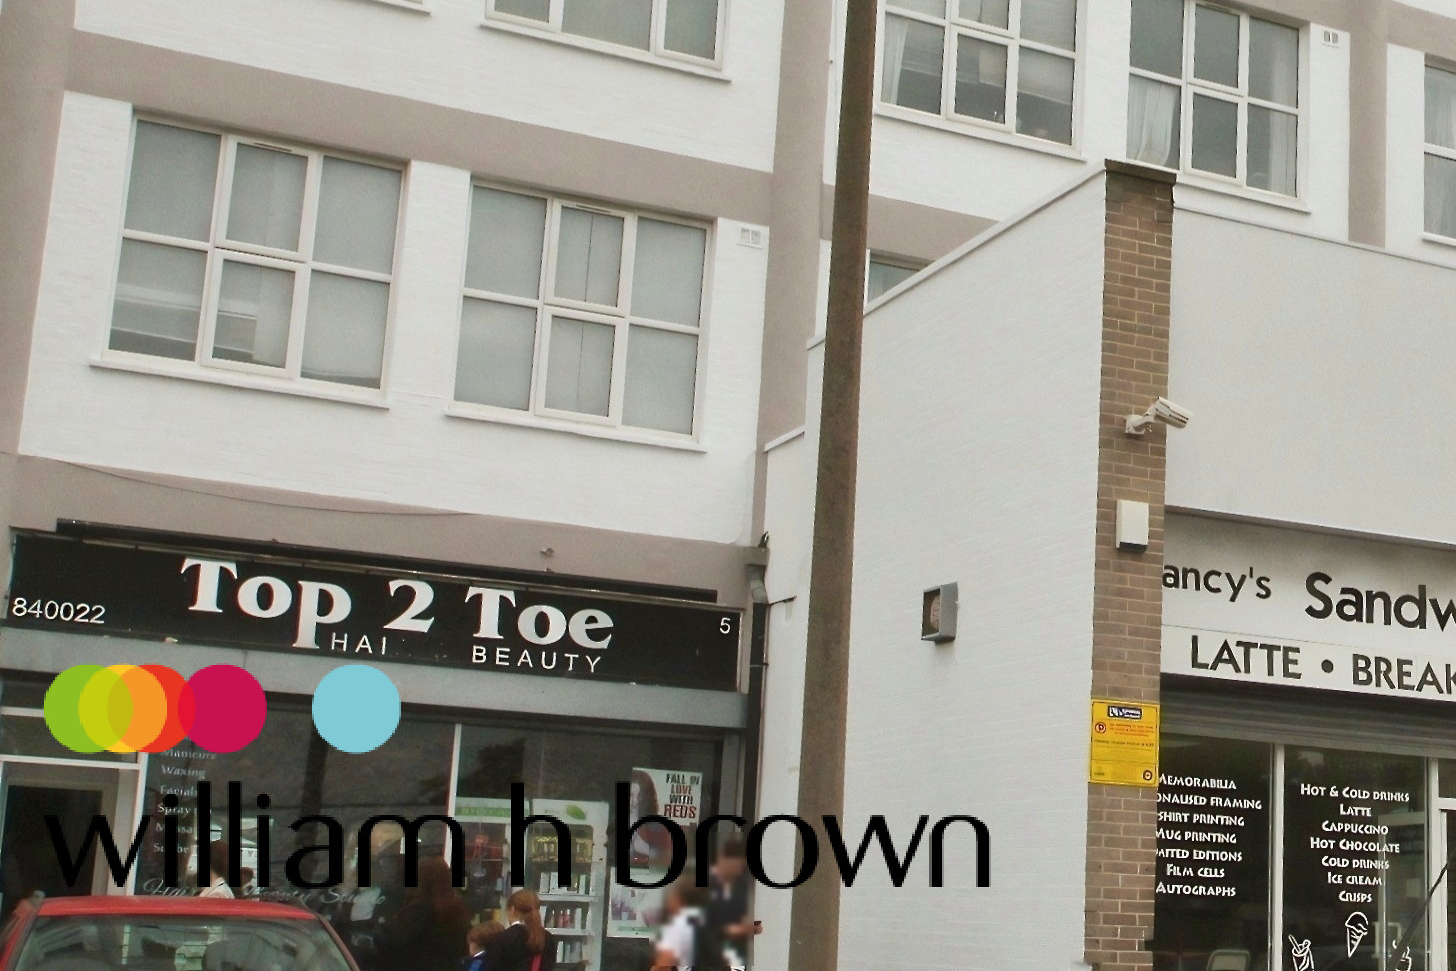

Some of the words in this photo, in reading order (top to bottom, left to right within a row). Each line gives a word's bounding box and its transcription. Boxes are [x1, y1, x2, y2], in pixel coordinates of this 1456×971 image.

[1161, 564, 1272, 603] ancy's
[12, 597, 106, 624] 840022
[180, 556, 353, 649] Top
[383, 578, 436, 633] 2
[464, 585, 615, 650] Toe
[719, 617, 732, 634] 5
[330, 631, 388, 656] HAI
[472, 644, 602, 674] BEAUTY
[1191, 634, 1302, 680] LATTE
[161, 764, 206, 780] Waxing
[670, 784, 693, 795] LOVE
[1300, 783, 1326, 796] HOT
[1329, 785, 1339, 797] &
[1342, 786, 1370, 799] COLD
[1372, 791, 1410, 802] DRINKS
[669, 794, 693, 805] WITH
[1210, 796, 1262, 810] FRAMING
[663, 804, 697, 819] REDS
[1340, 803, 1372, 817] LATTE
[1192, 813, 1245, 827] PRINTING
[1321, 820, 1389, 835] CAPPUCCINO
[1155, 827, 1182, 841] MUG
[1184, 831, 1237, 844] PRINTING
[1310, 836, 1336, 849] HOT
[1339, 838, 1400, 853] CHOCOLATE
[1192, 849, 1243, 862] EDITIONS
[1321, 855, 1349, 868] COLD
[1352, 859, 1390, 870] DRINKS
[1166, 863, 1194, 877] FILM
[1197, 867, 1225, 878] CELLS
[1327, 872, 1343, 884] ICE
[1346, 875, 1382, 886] CREAM
[1156, 881, 1237, 897] AUTOGRAPHS
[1338, 890, 1372, 903] CRISPS
